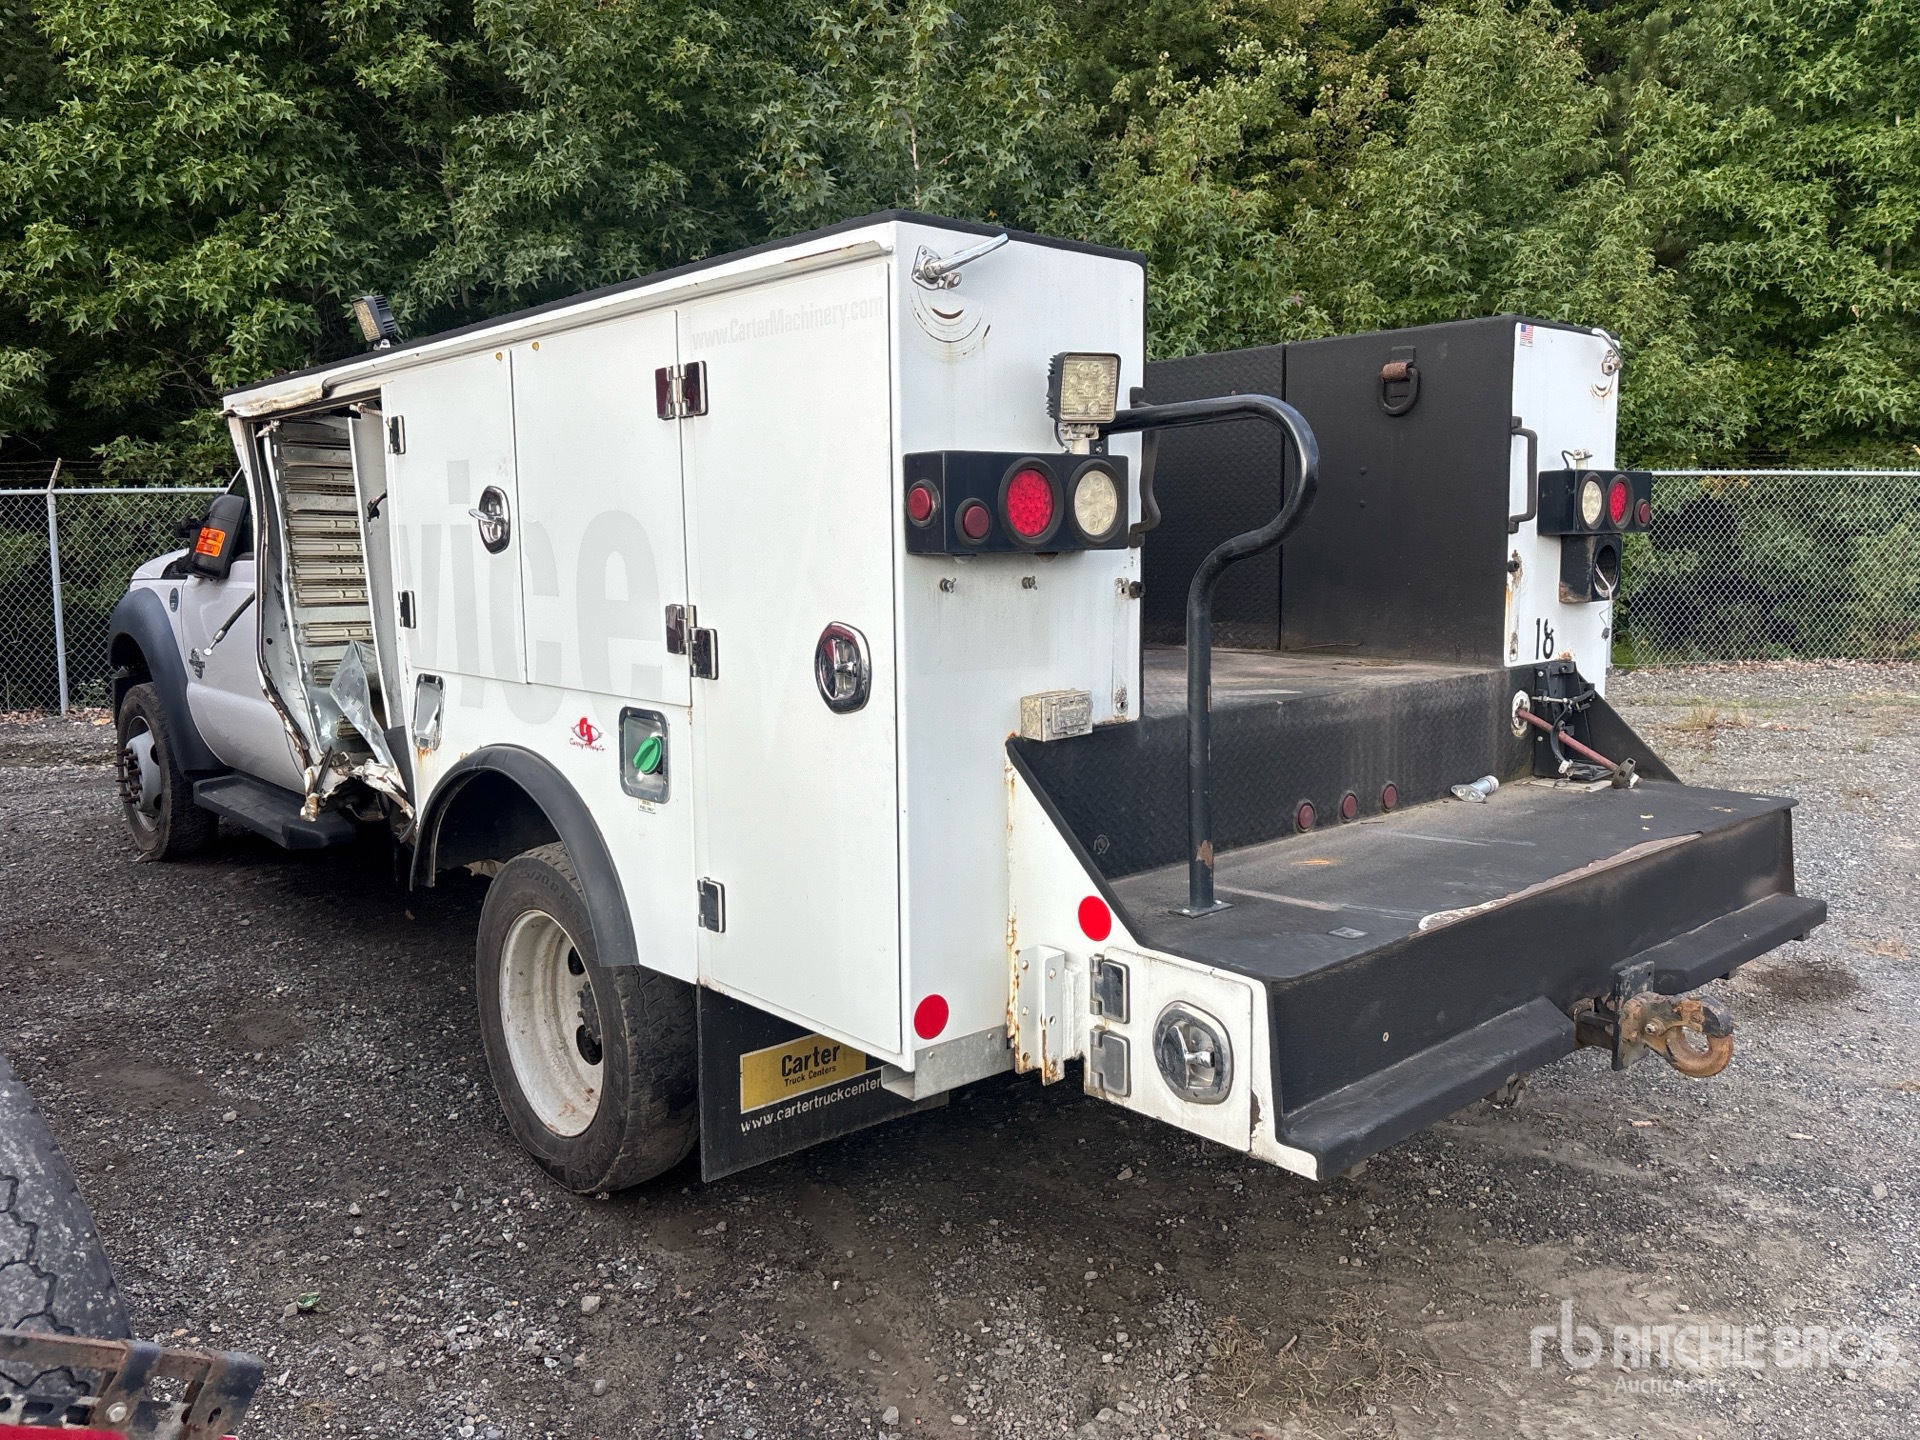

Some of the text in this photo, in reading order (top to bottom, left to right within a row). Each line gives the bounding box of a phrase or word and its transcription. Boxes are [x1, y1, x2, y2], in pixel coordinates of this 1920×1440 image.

[692, 296, 884, 350] www.CarterMachinery.com
[781, 1045, 841, 1078] Carter
[784, 1065, 837, 1088] Truck Centers
[740, 1076, 882, 1134] www.cartertruckcenter
